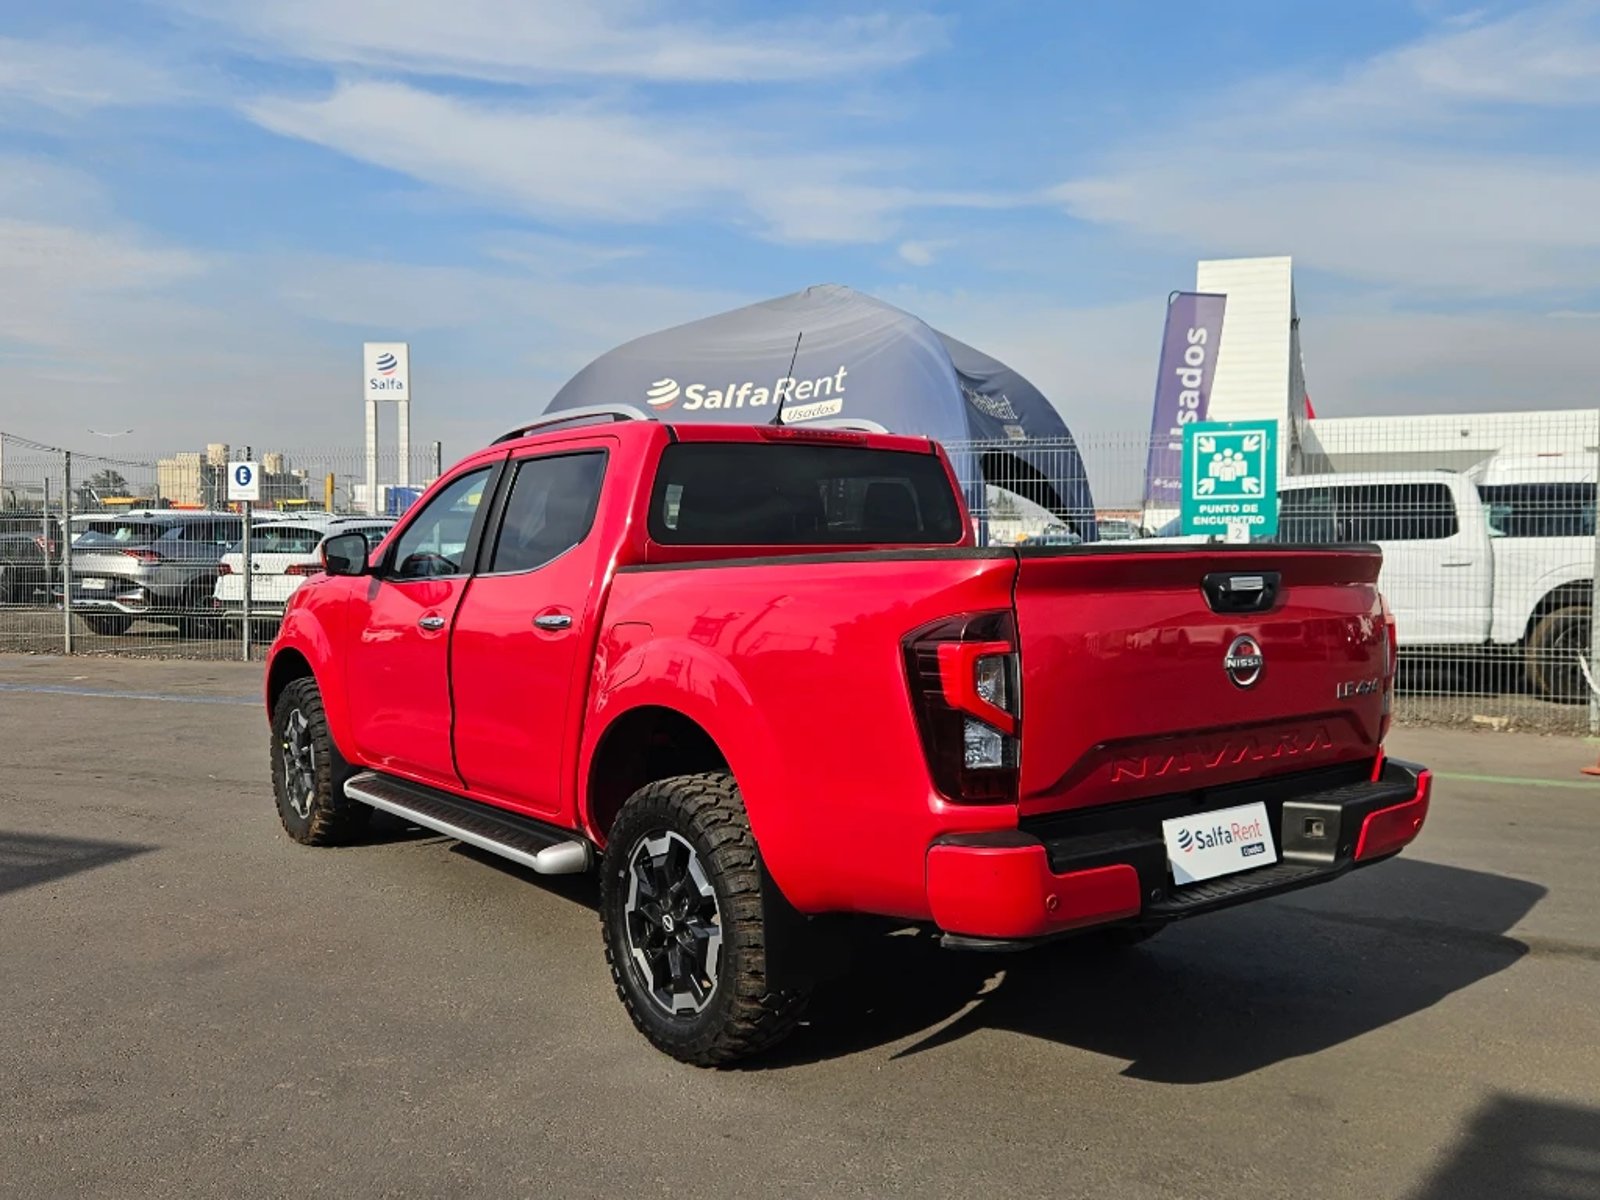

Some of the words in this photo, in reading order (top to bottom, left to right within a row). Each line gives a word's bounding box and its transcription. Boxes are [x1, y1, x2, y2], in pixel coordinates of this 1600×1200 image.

[370, 378, 403, 390] Salfa
[682, 366, 848, 410] SalfaRent
[787, 402, 836, 420] Usados
[239, 468, 249, 484] E
[1199, 504, 1240, 514] PUNTO
[1242, 503, 1259, 513] DE
[1192, 515, 1266, 526] ENCUENTRO
[1234, 528, 1243, 540] 2
[1111, 727, 1333, 783] NAVARA
[1194, 819, 1263, 850] SalfaRent
